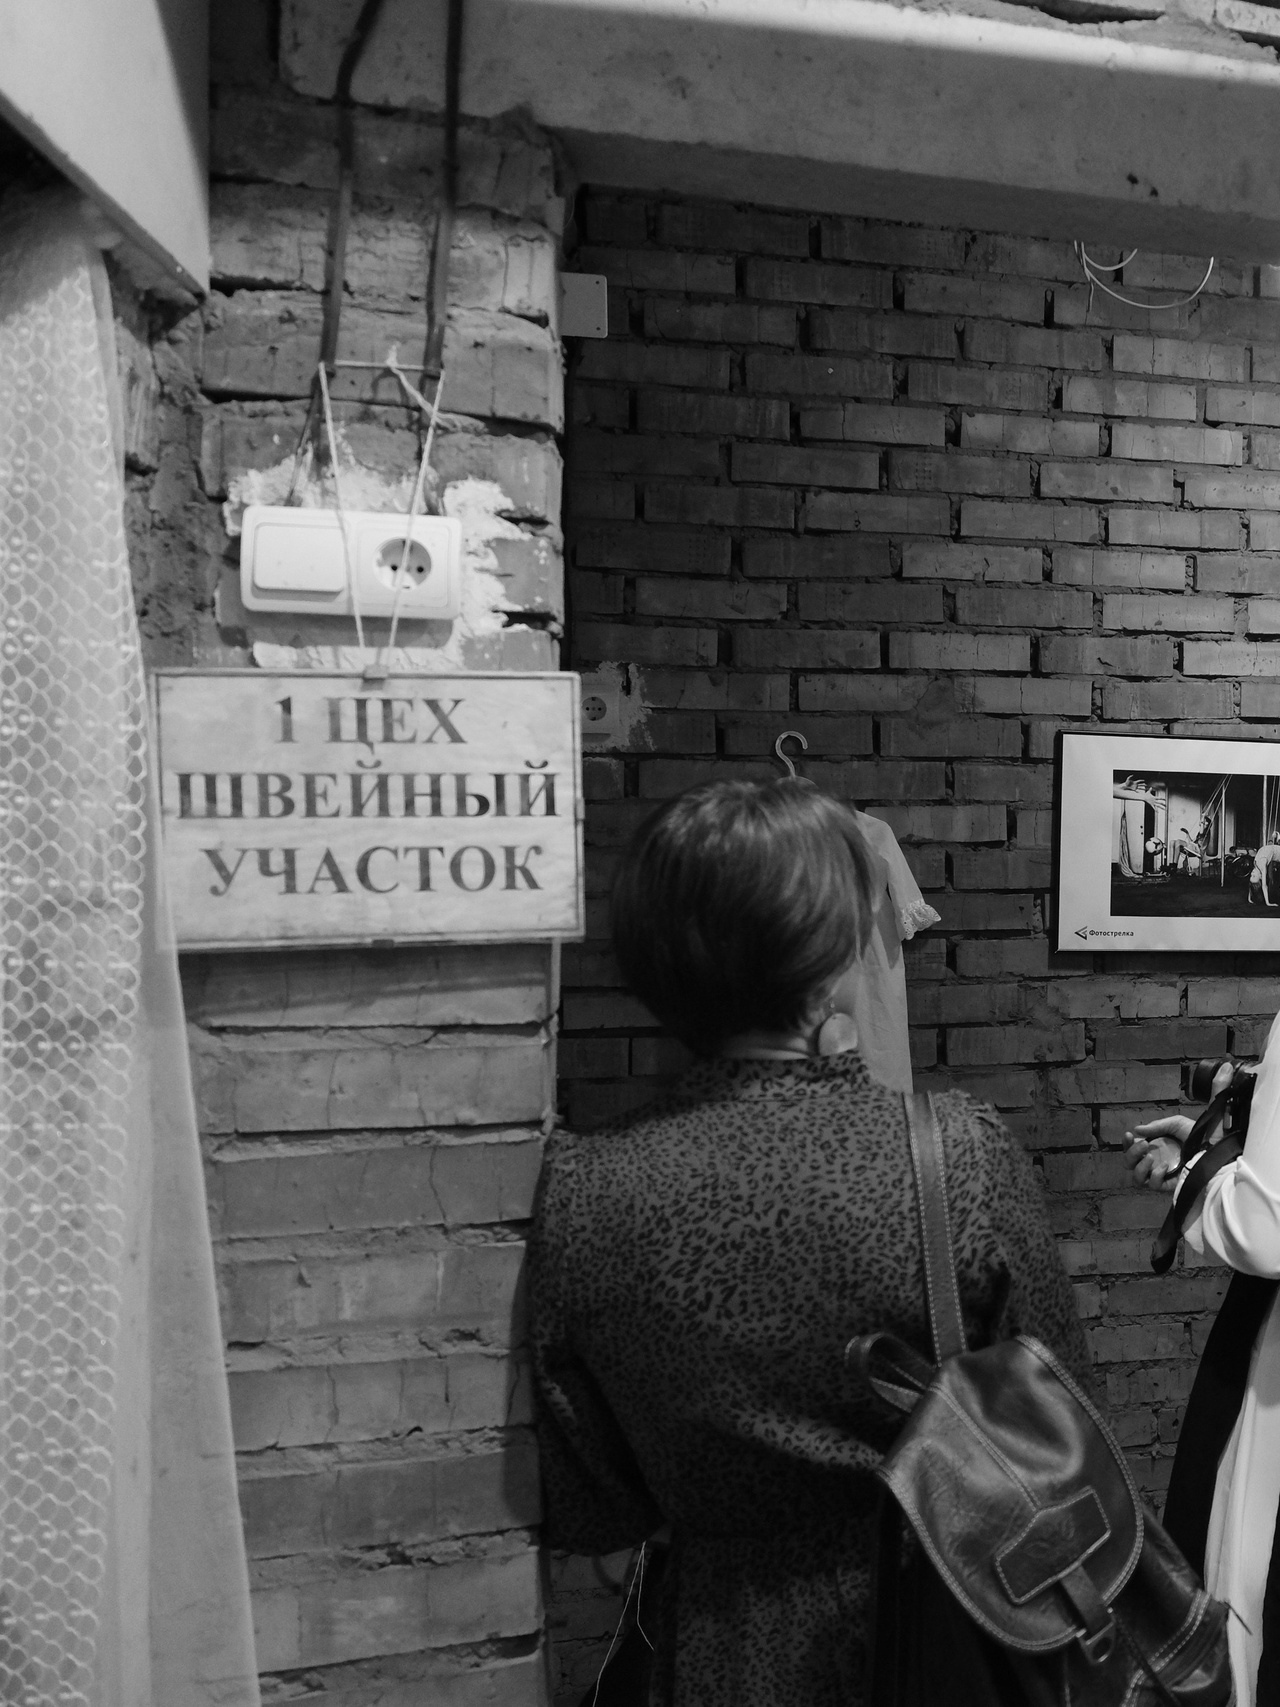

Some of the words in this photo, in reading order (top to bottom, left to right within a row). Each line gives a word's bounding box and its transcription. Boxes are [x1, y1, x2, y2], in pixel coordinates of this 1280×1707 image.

[274, 695, 299, 745] 1
[322, 696, 468, 755] ЦЕХ
[176, 759, 562, 819] ШВЕЙНЫЙ
[200, 844, 544, 897] УЧАСТОК
[1088, 929, 1135, 938] Фотострелка
